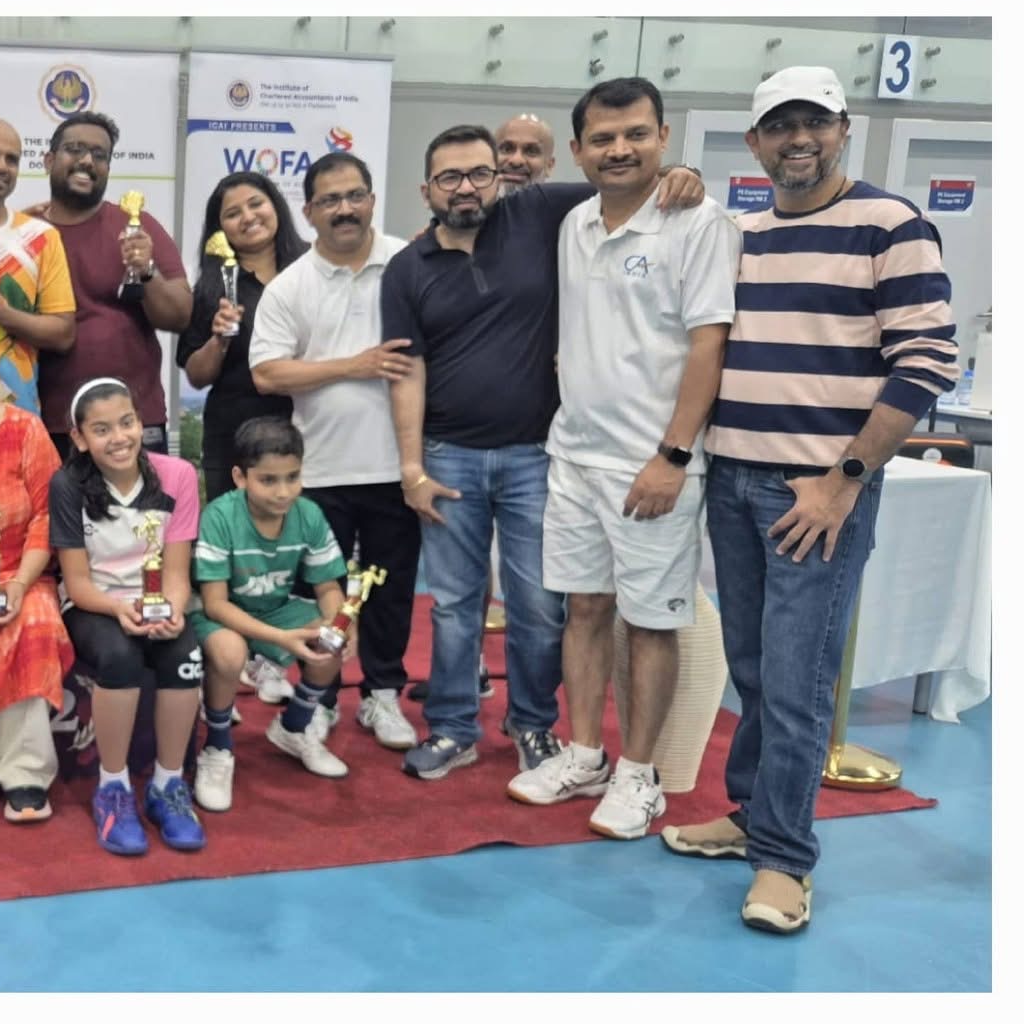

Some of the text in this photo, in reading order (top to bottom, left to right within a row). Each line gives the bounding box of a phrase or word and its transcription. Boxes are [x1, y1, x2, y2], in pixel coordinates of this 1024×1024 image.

[884, 40, 913, 94] 3
[24, 137, 43, 147] THE
[128, 152, 156, 161] INDIA
[29, 161, 44, 170] DO
